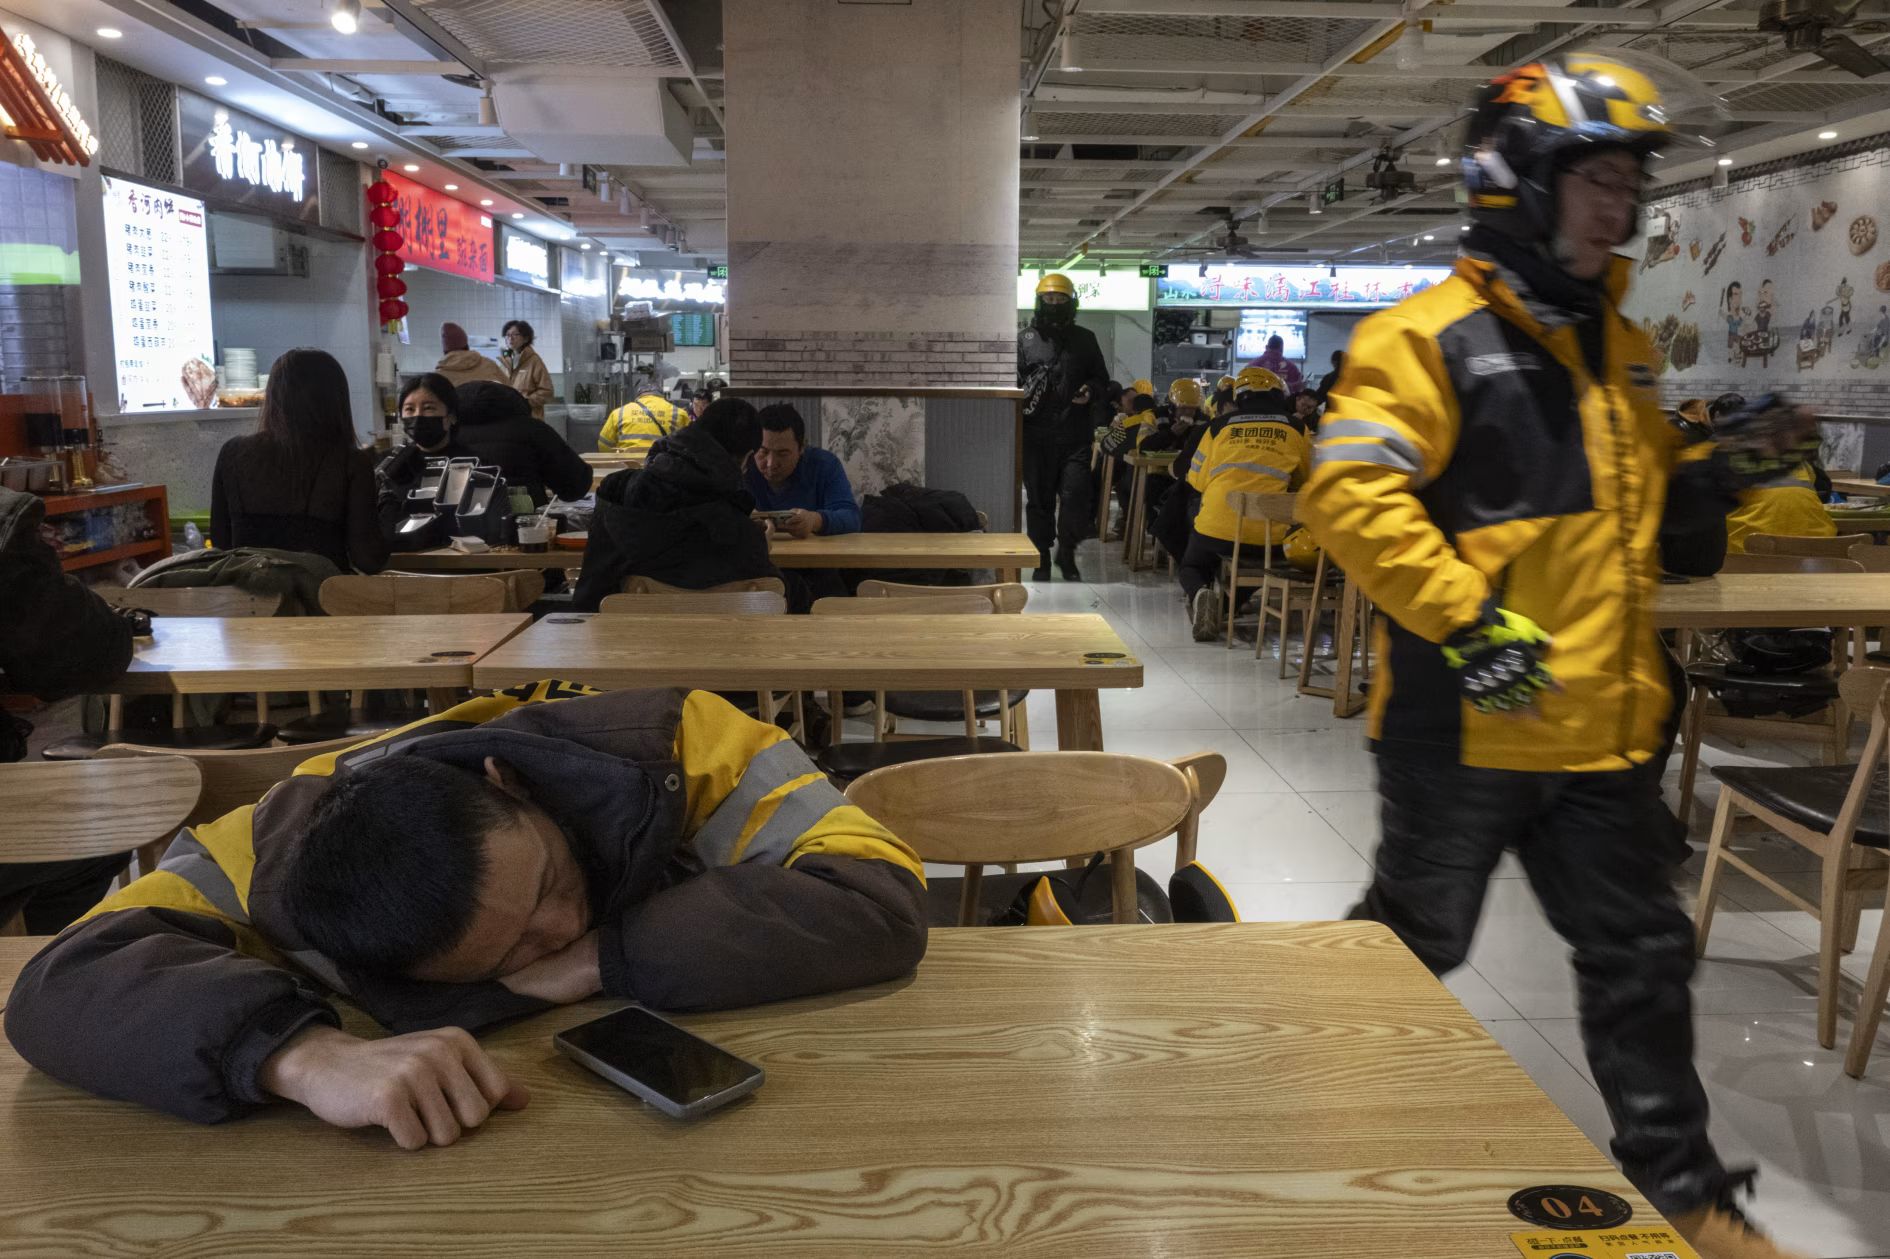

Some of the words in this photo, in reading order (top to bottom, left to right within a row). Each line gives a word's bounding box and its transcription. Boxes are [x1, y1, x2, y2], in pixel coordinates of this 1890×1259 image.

[1231, 427, 1287, 442] 美团团购
[1541, 1195, 1604, 1219] 04
